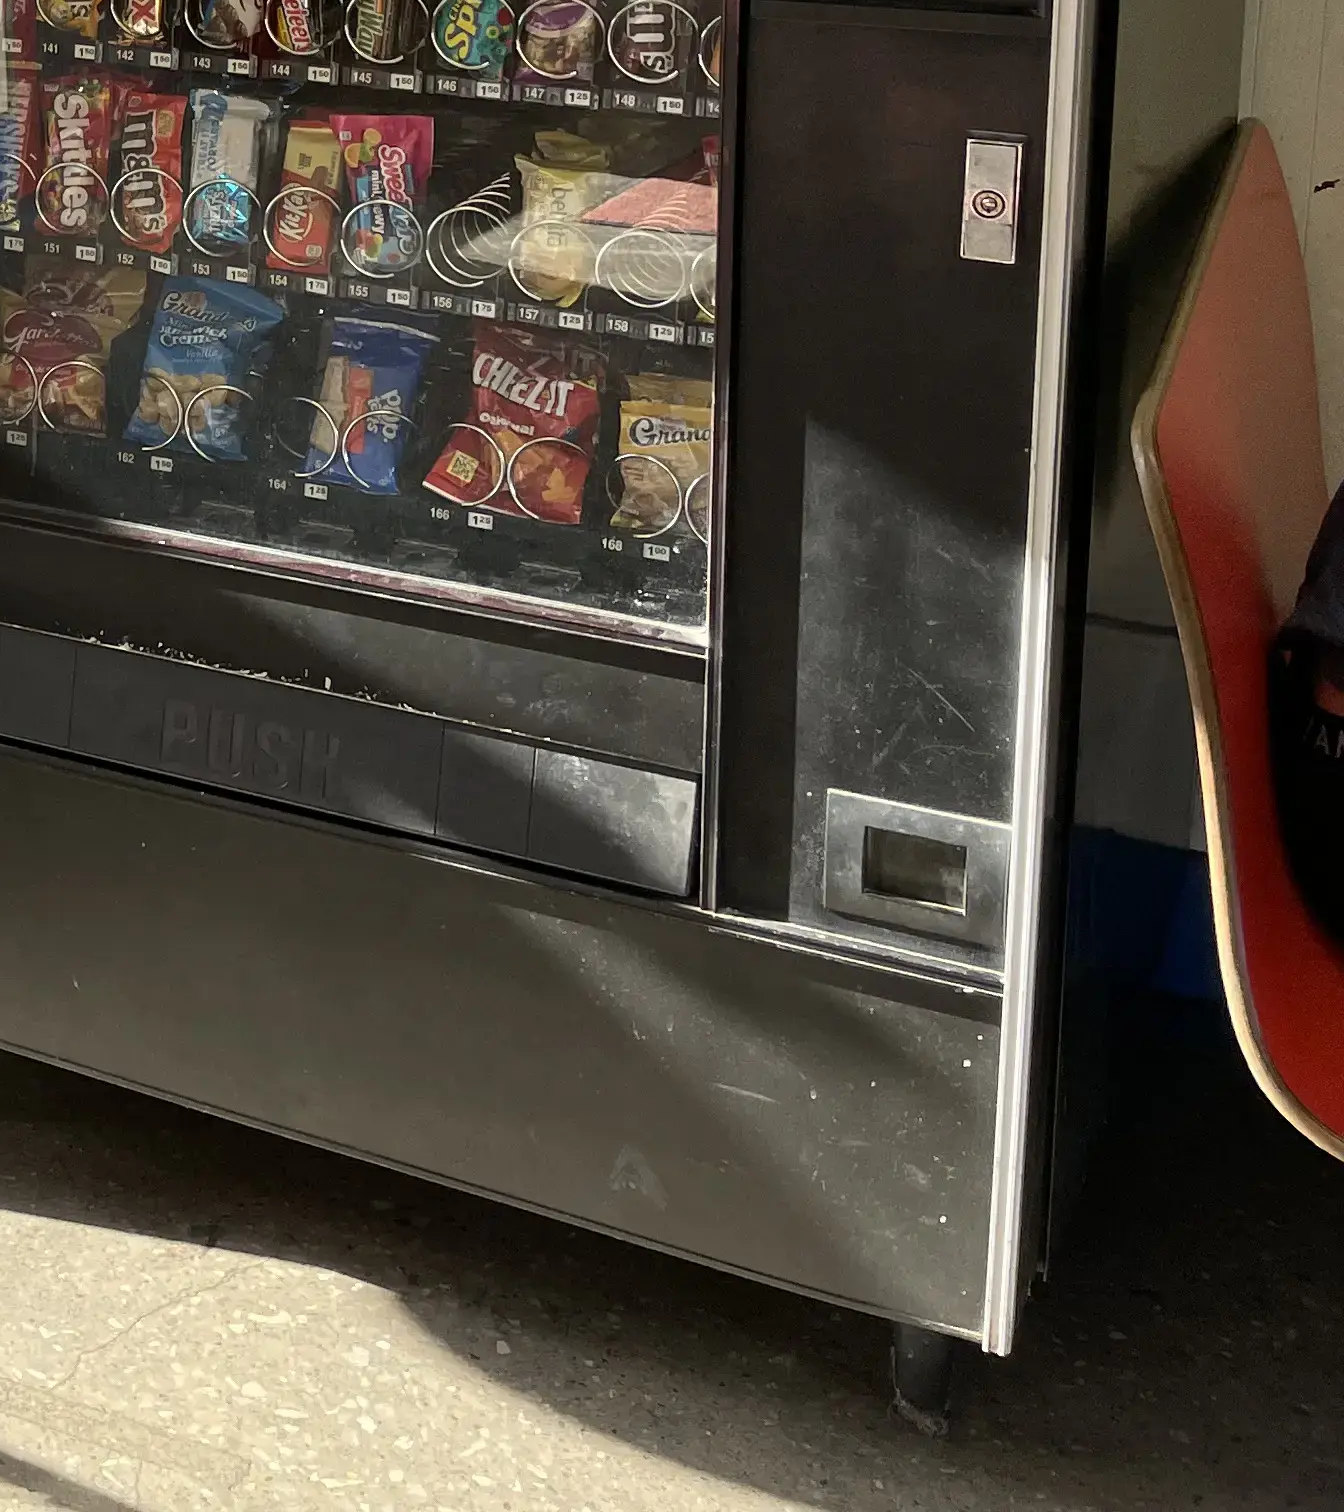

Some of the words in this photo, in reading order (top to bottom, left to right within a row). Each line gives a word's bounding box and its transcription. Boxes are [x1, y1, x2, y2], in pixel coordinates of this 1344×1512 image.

[42, 42, 59, 54] 141
[116, 50, 134, 62] 142
[193, 57, 211, 68] 143
[271, 64, 290, 76] 144
[353, 71, 373, 83] 145
[437, 80, 457, 92] 146
[524, 88, 545, 100] 147
[614, 94, 635, 107] 148
[53, 91, 97, 229] Skittles
[44, 242, 61, 254] 151
[116, 253, 134, 265] 152
[192, 263, 210, 275] 153
[269, 274, 288, 287] 154
[348, 285, 369, 298] 155
[432, 296, 453, 309] 156
[519, 308, 540, 321] 157
[607, 319, 628, 332] 158
[116, 452, 135, 464] 162
[268, 478, 287, 491] 164
[430, 507, 450, 520] 166
[601, 537, 623, 551] 168
[160, 698, 342, 800] PUSH
